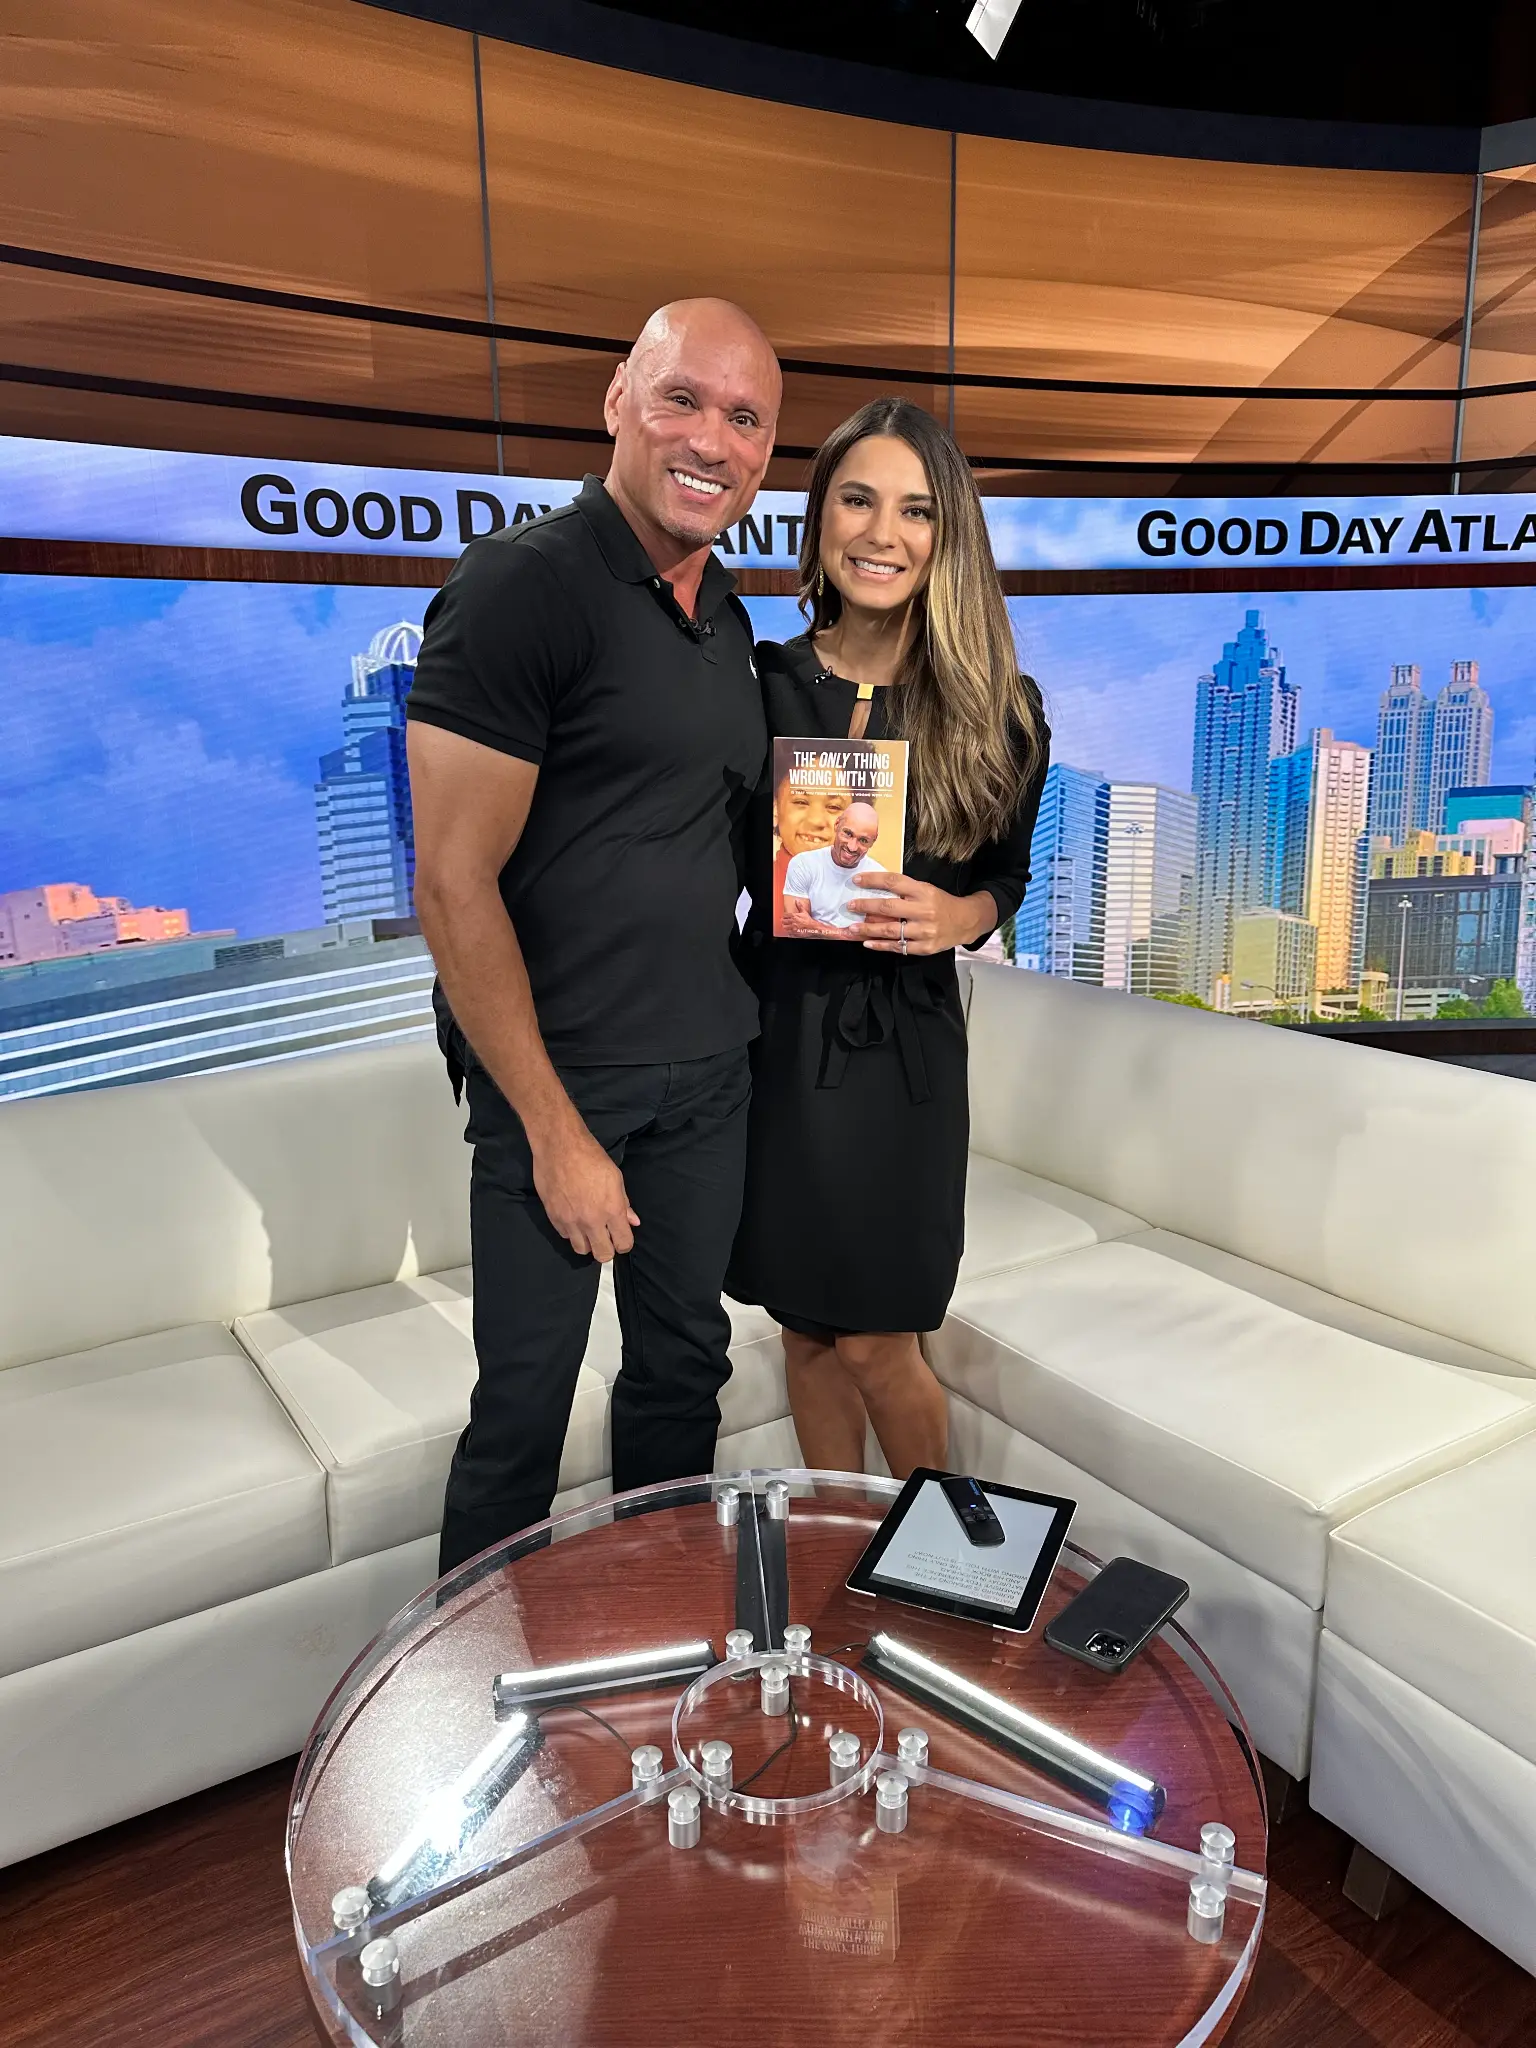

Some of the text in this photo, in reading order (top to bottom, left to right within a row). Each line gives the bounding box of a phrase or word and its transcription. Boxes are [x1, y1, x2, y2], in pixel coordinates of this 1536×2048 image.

[241, 474, 442, 542] GOOD
[1137, 510, 1288, 556] GOOD
[1300, 510, 1403, 555] DAY
[793, 751, 890, 769] THE ONLY THING
[789, 769, 894, 787] WRONG WITH YOU
